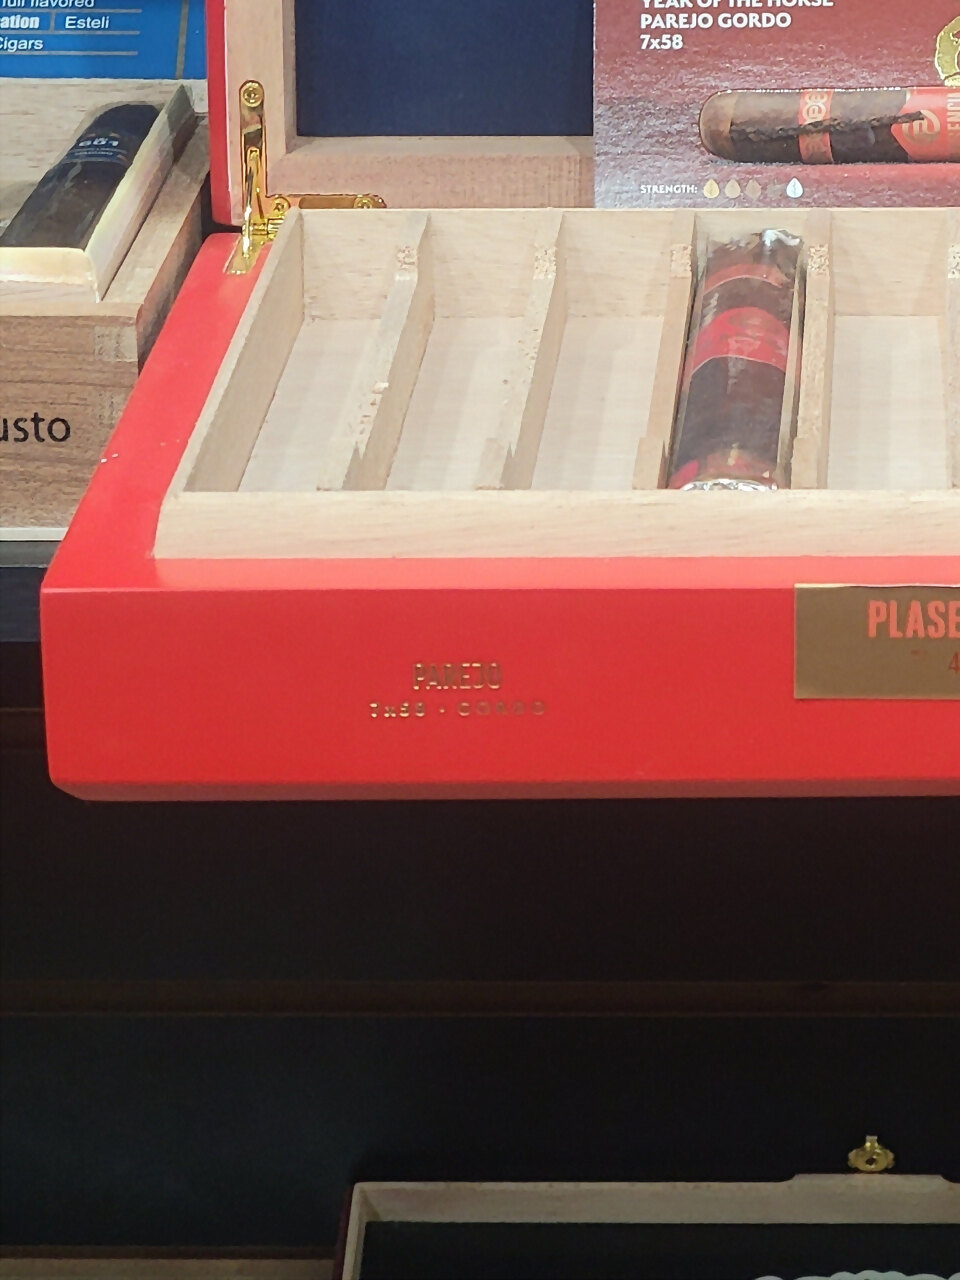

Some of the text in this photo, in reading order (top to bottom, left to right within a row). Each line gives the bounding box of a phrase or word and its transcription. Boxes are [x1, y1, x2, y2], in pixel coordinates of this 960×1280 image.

[640, 12, 792, 30] PAREJO GORDO
[640, 33, 684, 50] 7x58
[640, 183, 698, 195] STRENGTH:
[412, 662, 501, 691] PAREJO
